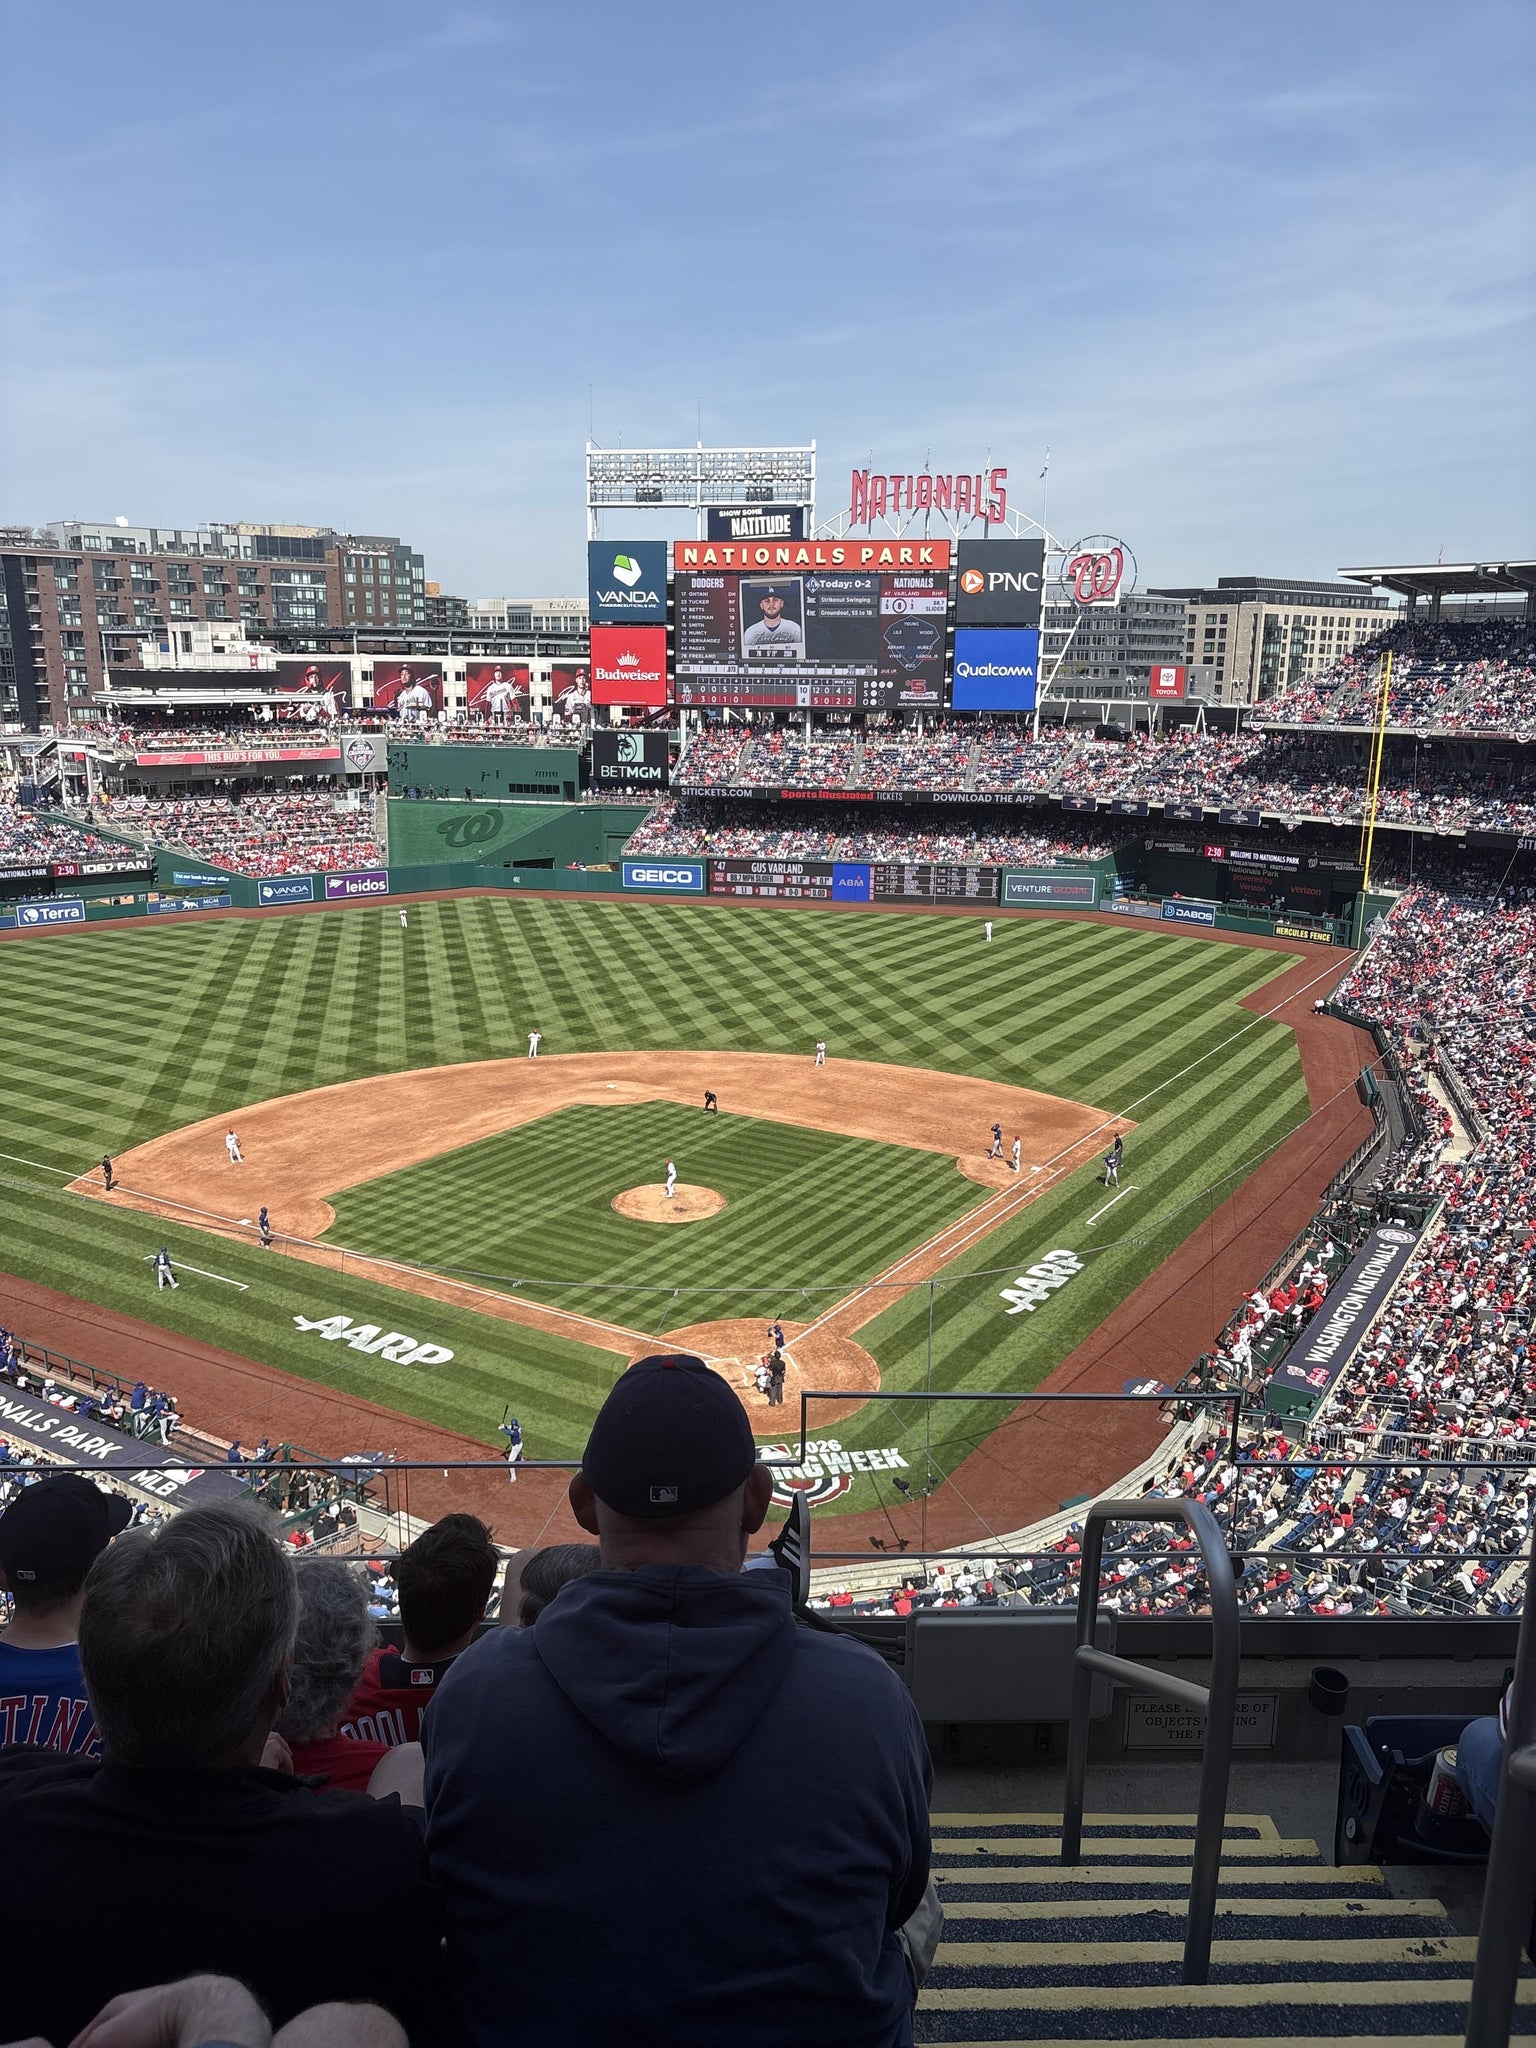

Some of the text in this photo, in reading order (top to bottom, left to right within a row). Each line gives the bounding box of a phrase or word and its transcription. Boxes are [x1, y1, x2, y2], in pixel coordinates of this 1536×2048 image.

[851, 468, 1007, 524] NATIONALS
[718, 508, 763, 518] SHOW SOME
[731, 513, 792, 537] NATITUDE
[684, 547, 935, 566] NATIONALS PARK
[691, 578, 725, 589] DODGERS
[820, 580, 871, 589] Today: 0-2
[893, 577, 934, 588] NATIONALS
[987, 572, 1039, 592] PNC
[596, 590, 660, 603] VANDA
[594, 667, 661, 681] Budweiser
[956, 662, 1033, 678] Qualcomm
[204, 750, 282, 762] THIS BUD'S FOR YOU.
[600, 765, 662, 779] BETMGM
[681, 787, 752, 798] SITICKETS.COM
[781, 789, 874, 800] Sports Illustrated
[876, 791, 903, 800] TICKETS
[933, 793, 1036, 803] DOWNLOAD THE APP
[1207, 847, 1222, 857] 2:30
[1230, 850, 1252, 859] WELCOME
[1260, 853, 1286, 863] NATIONALS
[1286, 856, 1300, 865] PARK
[57, 865, 74, 876] 2:30
[117, 860, 148, 870] FAN
[751, 862, 803, 874] GUS VARLAND
[0, 868, 47, 878] NATIONALS PARK
[631, 869, 693, 883] GEICO
[1228, 865, 1279, 878] Nationals Park
[756, 875, 774, 883] SLIDER
[838, 879, 864, 887] ABM
[1233, 874, 1273, 886] powered by
[273, 884, 309, 894] VANDA
[346, 879, 386, 893] leidos
[1011, 884, 1088, 895] VENTURE GLOBAL
[1240, 883, 1266, 893] Verizon
[1291, 886, 1322, 896] verizon
[39, 906, 80, 920] Terra
[1175, 909, 1213, 920] DABOS
[1276, 926, 1332, 942] HERCULES FENCE
[999, 1249, 1085, 1315] AARP
[1304, 1291, 1365, 1363] WASHINGTON
[1351, 1243, 1400, 1295] NATIONALS
[292, 1315, 455, 1366] AARP
[50, 1425, 124, 1460] PARK
[793, 1439, 842, 1456] 2026
[820, 1447, 910, 1475] WEEK
[128, 1469, 179, 1497] MLB
[1134, 1703, 1182, 1713] PLEASE
[1253, 1703, 1270, 1713] OF
[1145, 1716, 1200, 1729] OBJECTS
[1167, 1729, 1193, 1739] THE
